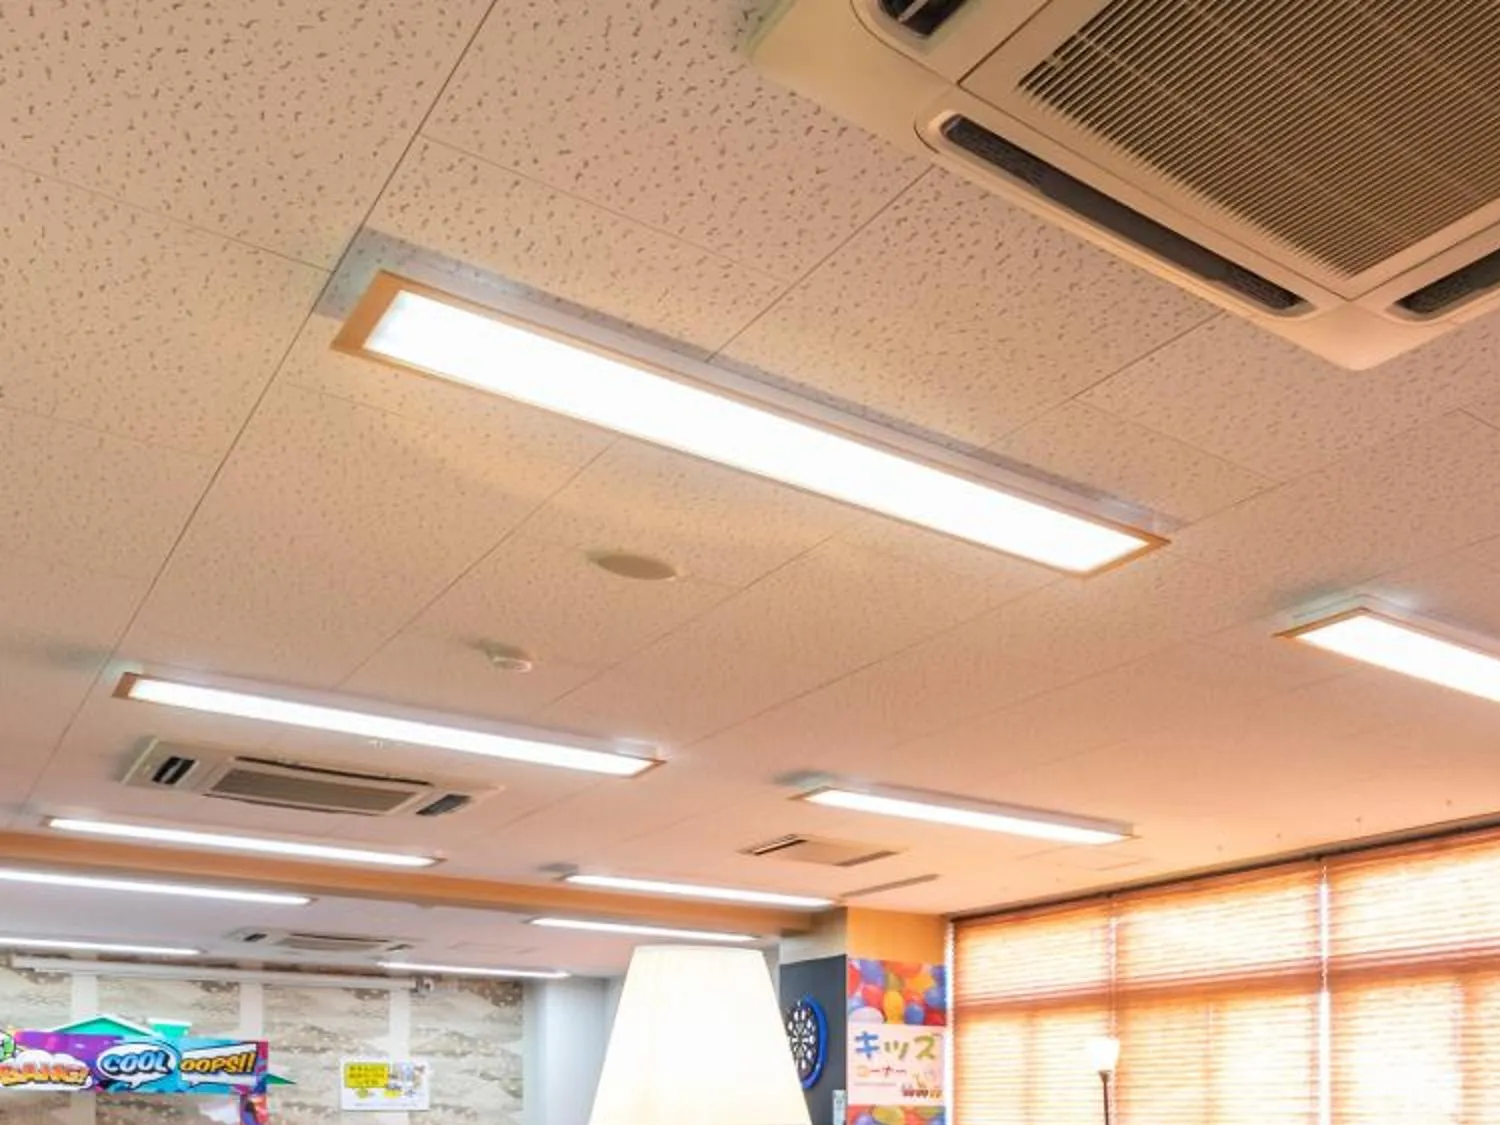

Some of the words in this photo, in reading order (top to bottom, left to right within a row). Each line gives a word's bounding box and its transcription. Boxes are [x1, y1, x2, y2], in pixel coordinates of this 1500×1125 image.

[854, 1031, 943, 1060] キッズ
[101, 1050, 171, 1075] COOL
[180, 1051, 258, 1074] OOPS!!
